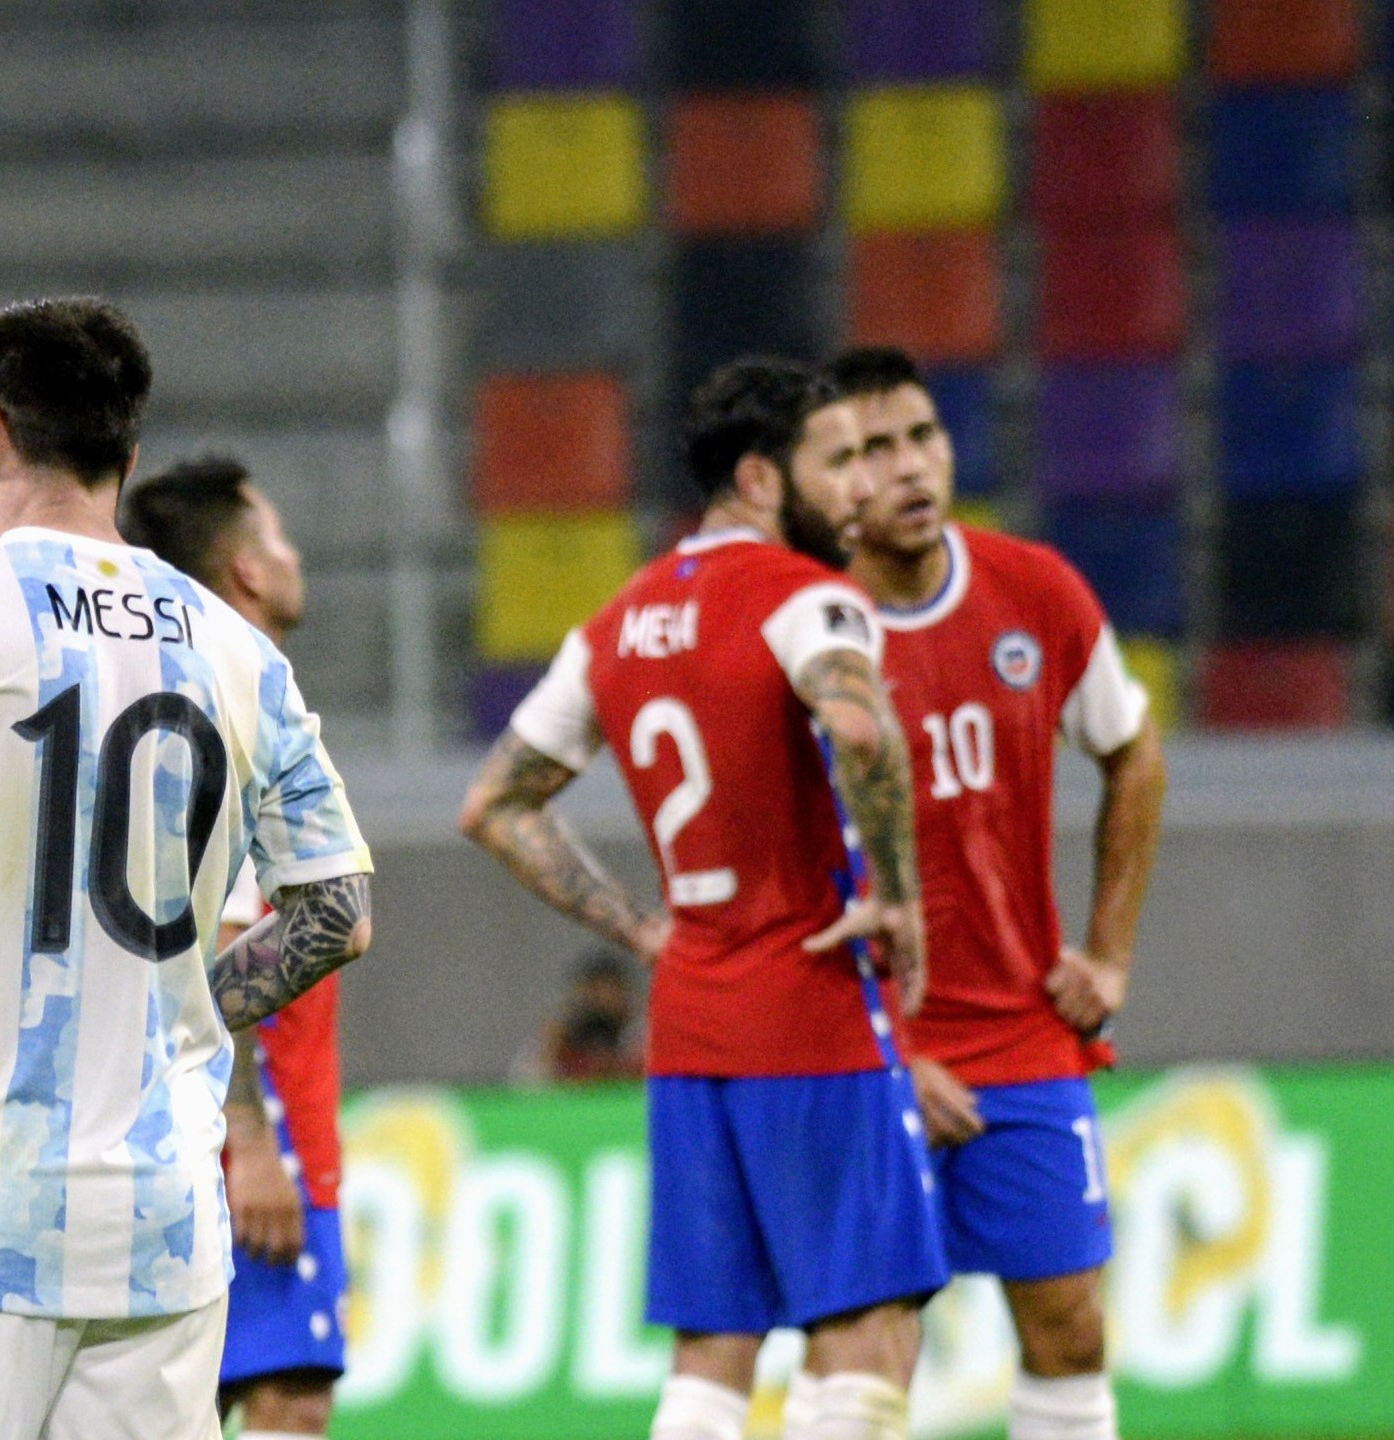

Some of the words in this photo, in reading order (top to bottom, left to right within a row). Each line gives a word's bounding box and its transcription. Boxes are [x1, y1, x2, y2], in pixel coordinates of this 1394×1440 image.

[46, 583, 194, 650] MESSI
[10, 683, 228, 963] 10
[630, 697, 738, 906] 2
[921, 702, 995, 800] 10
